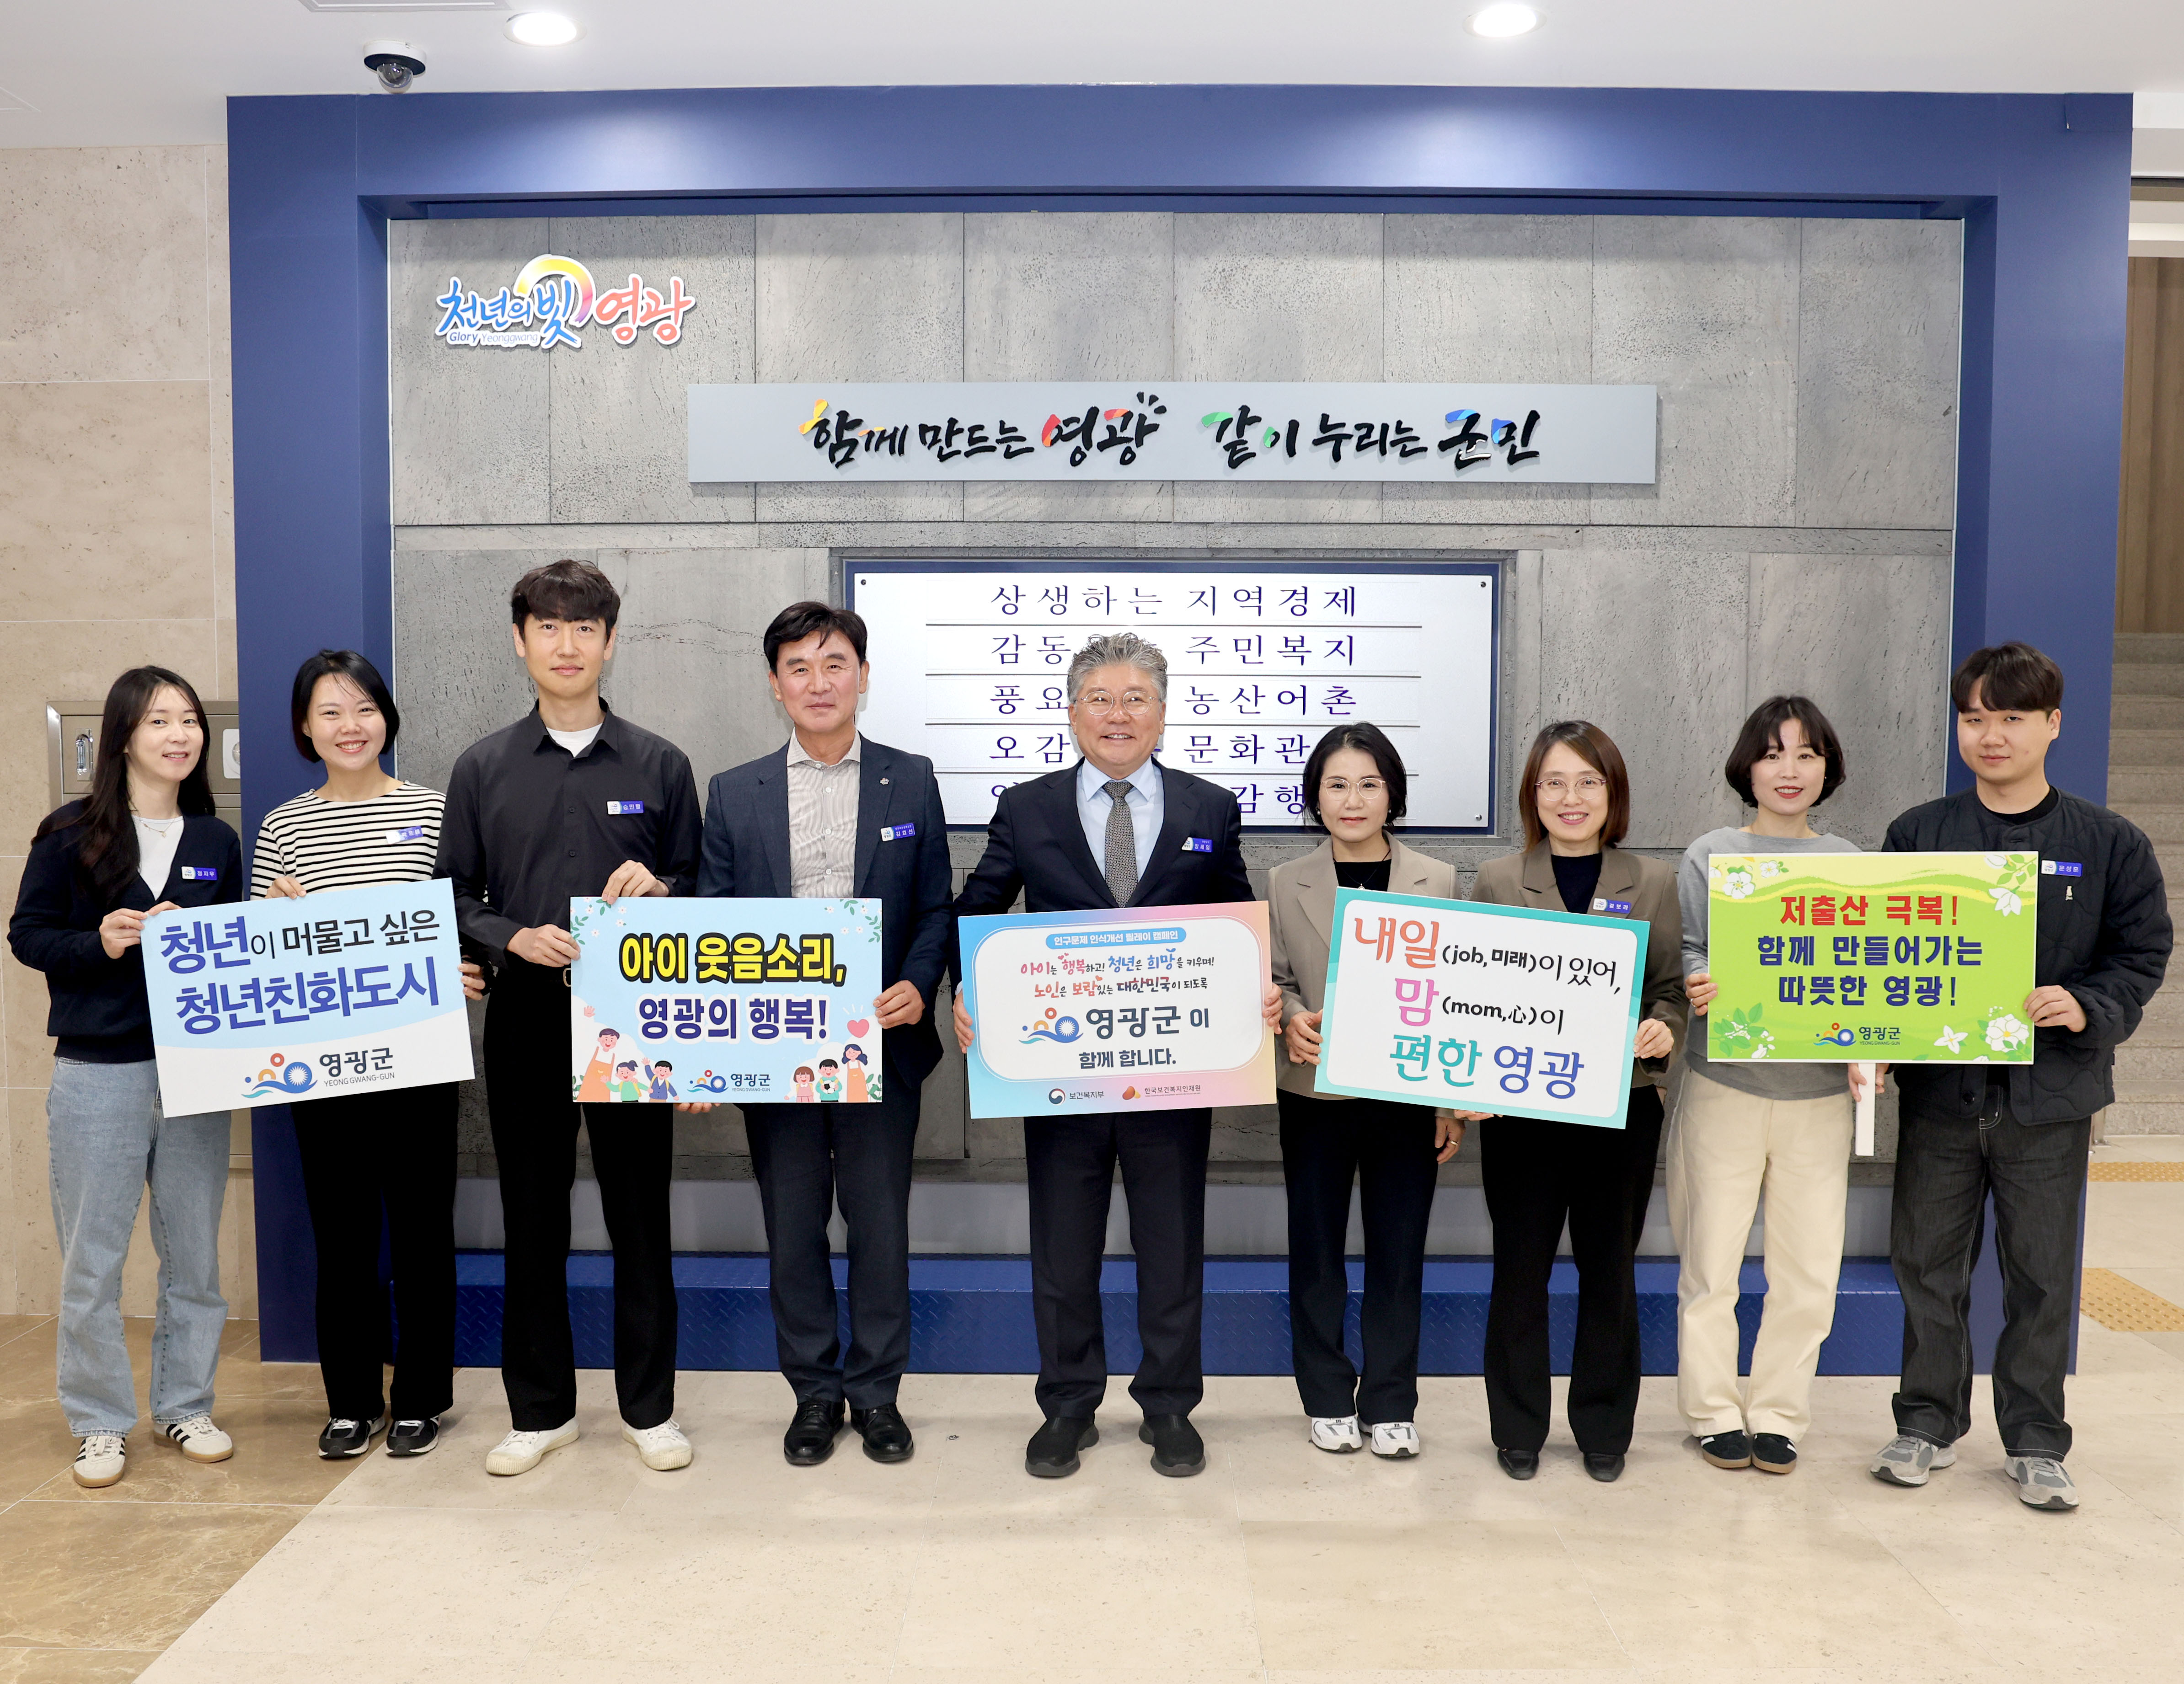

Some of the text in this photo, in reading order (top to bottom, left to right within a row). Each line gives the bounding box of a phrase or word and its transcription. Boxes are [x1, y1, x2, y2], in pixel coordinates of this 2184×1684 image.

[595, 276, 693, 342] 영광
[450, 332, 538, 343] Glory Yeonggwang
[798, 398, 1541, 470] 함께 만드는 영광 같이 누리는 군민
[990, 584, 1355, 617] 상생하는 지역경제
[1185, 634, 1354, 666] 주민복지
[1184, 684, 1356, 715] 농산어촌
[1183, 734, 1311, 764] 문화관
[1780, 895, 1958, 926] 저출산 극복!
[160, 909, 440, 974] 청년이 머물고 싶은
[1054, 930, 1178, 946] 인구문제 인식개선 릴레이 캠페인
[1757, 936, 1983, 966] 함께 만들어가는
[620, 933, 846, 986] 아이 웃음소리,
[1020, 961, 1057, 976] 아이는
[1061, 958, 1105, 975] 행복하고!
[1108, 955, 1143, 973] 청년은
[1187, 957, 1215, 967] 키우며!
[1034, 981, 1067, 998] 노인은
[1116, 976, 1181, 993] 대한민국이
[1183, 977, 1208, 989] 되도록
[1567, 958, 1621, 995] 있어,
[1778, 975, 1956, 1007] 따뜻한 영광!
[176, 956, 439, 1035] 청년친화도시
[640, 998, 827, 1040] 영광의 행복!
[1086, 1006, 1210, 1040] 영광군 이
[1858, 1026, 1901, 1041] 영광군
[319, 1047, 393, 1078] 영광군
[1078, 1048, 1177, 1069] 함께 합니다.
[1390, 1034, 1585, 1100] 편한 영광
[324, 1072, 395, 1087] YEONG GWANG-GUN
[730, 1074, 771, 1087] 영광군
[1144, 1085, 1201, 1095] 한국보건복지인재원
[1069, 1091, 1104, 1101] 보건복지부
